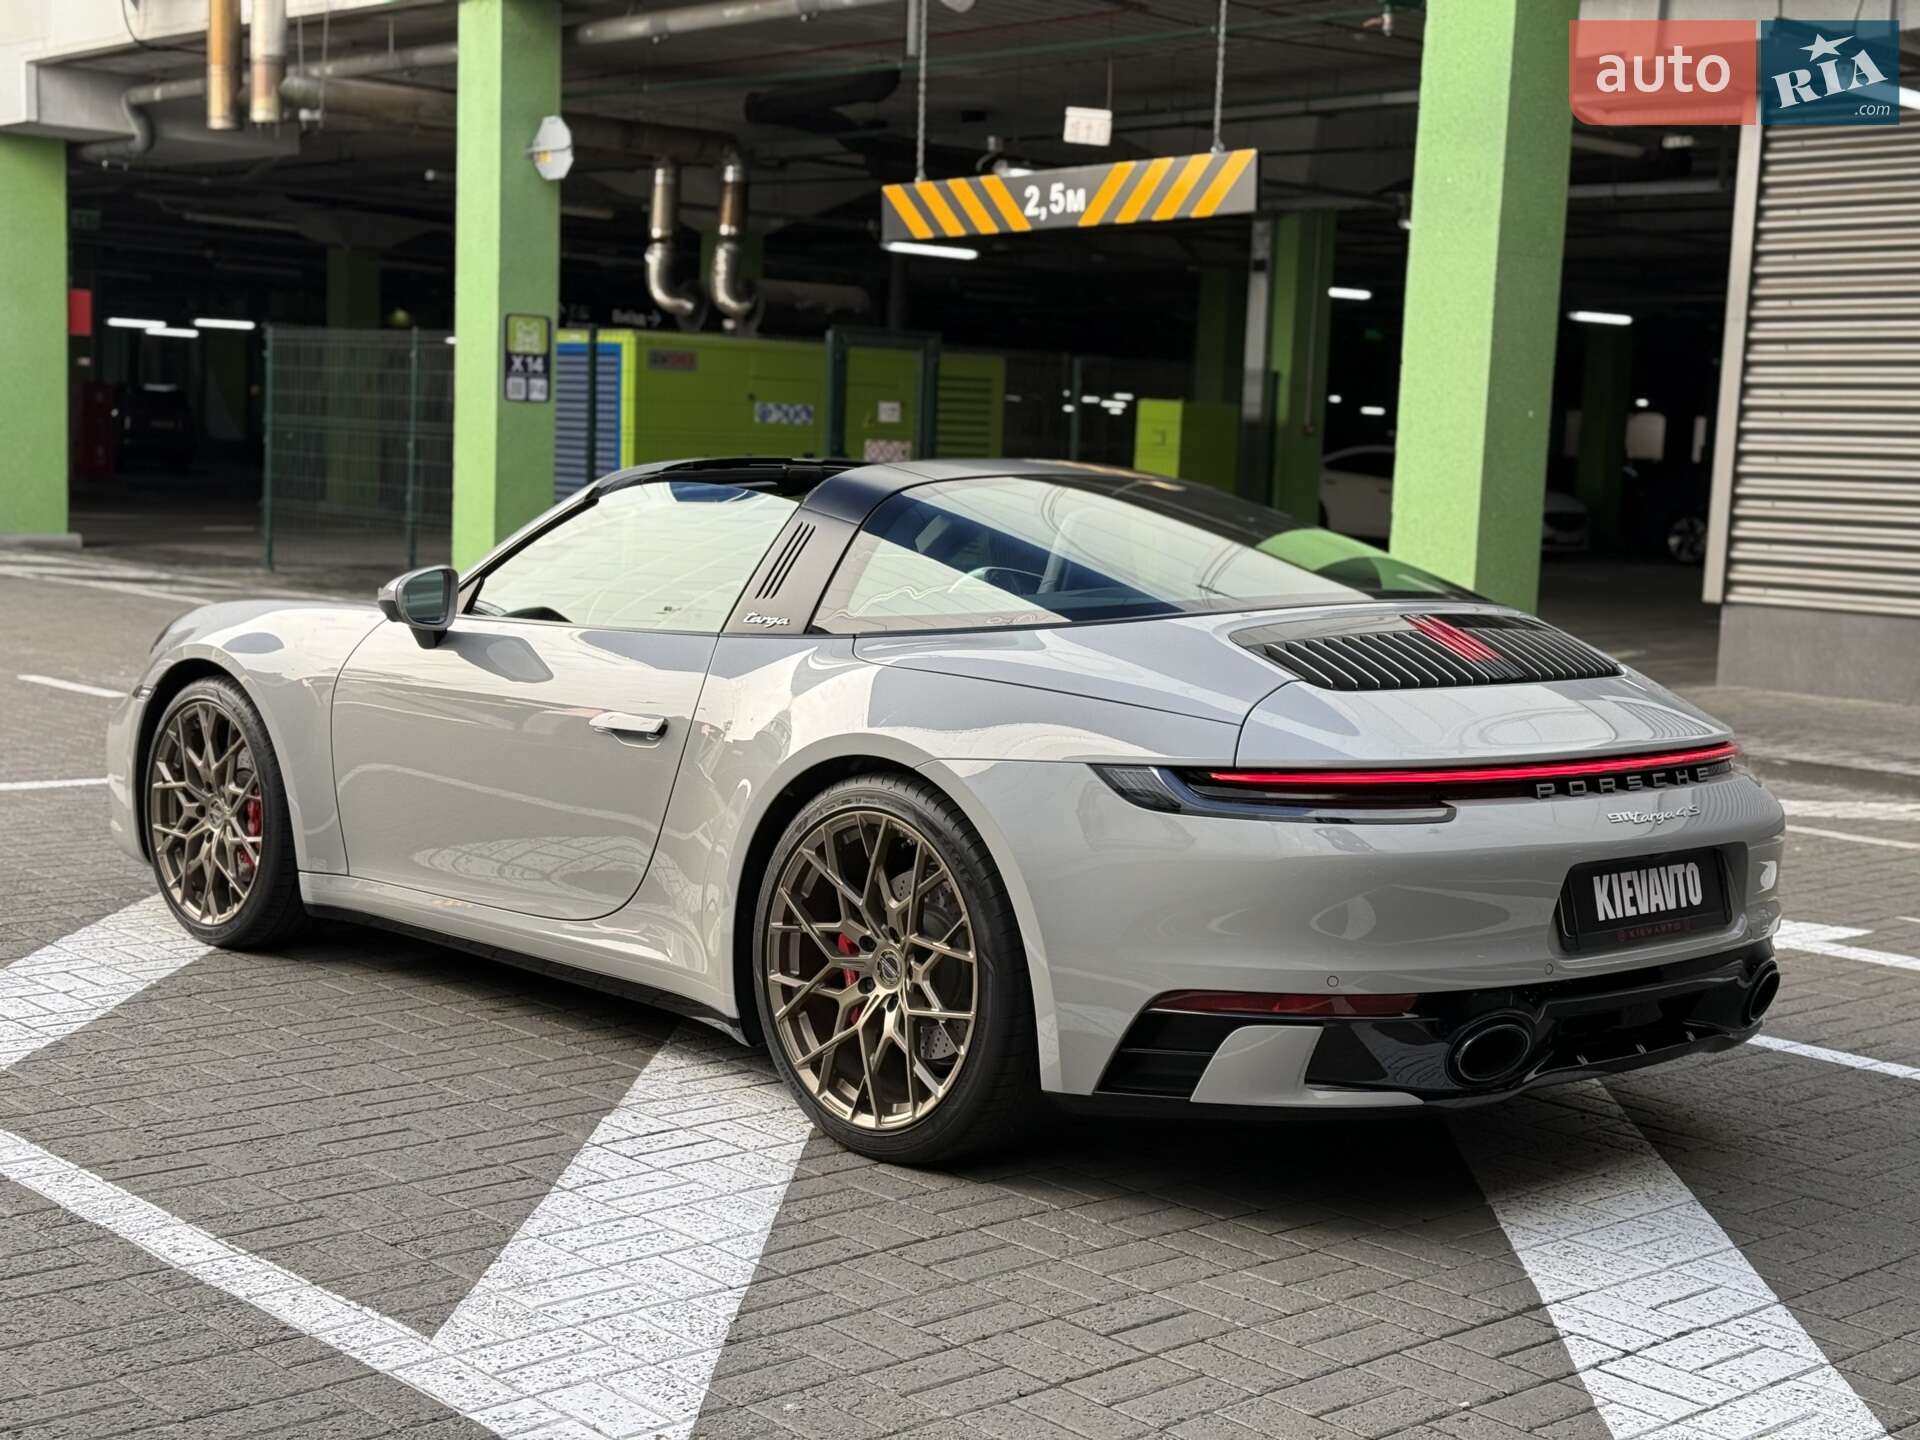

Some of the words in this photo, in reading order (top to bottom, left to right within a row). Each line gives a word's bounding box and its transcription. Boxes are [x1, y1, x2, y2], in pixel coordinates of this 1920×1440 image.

[526, 355, 544, 373] 14
[1536, 767, 1711, 799] PORSCHE
[1593, 862, 1703, 921] KIEVAVTO
